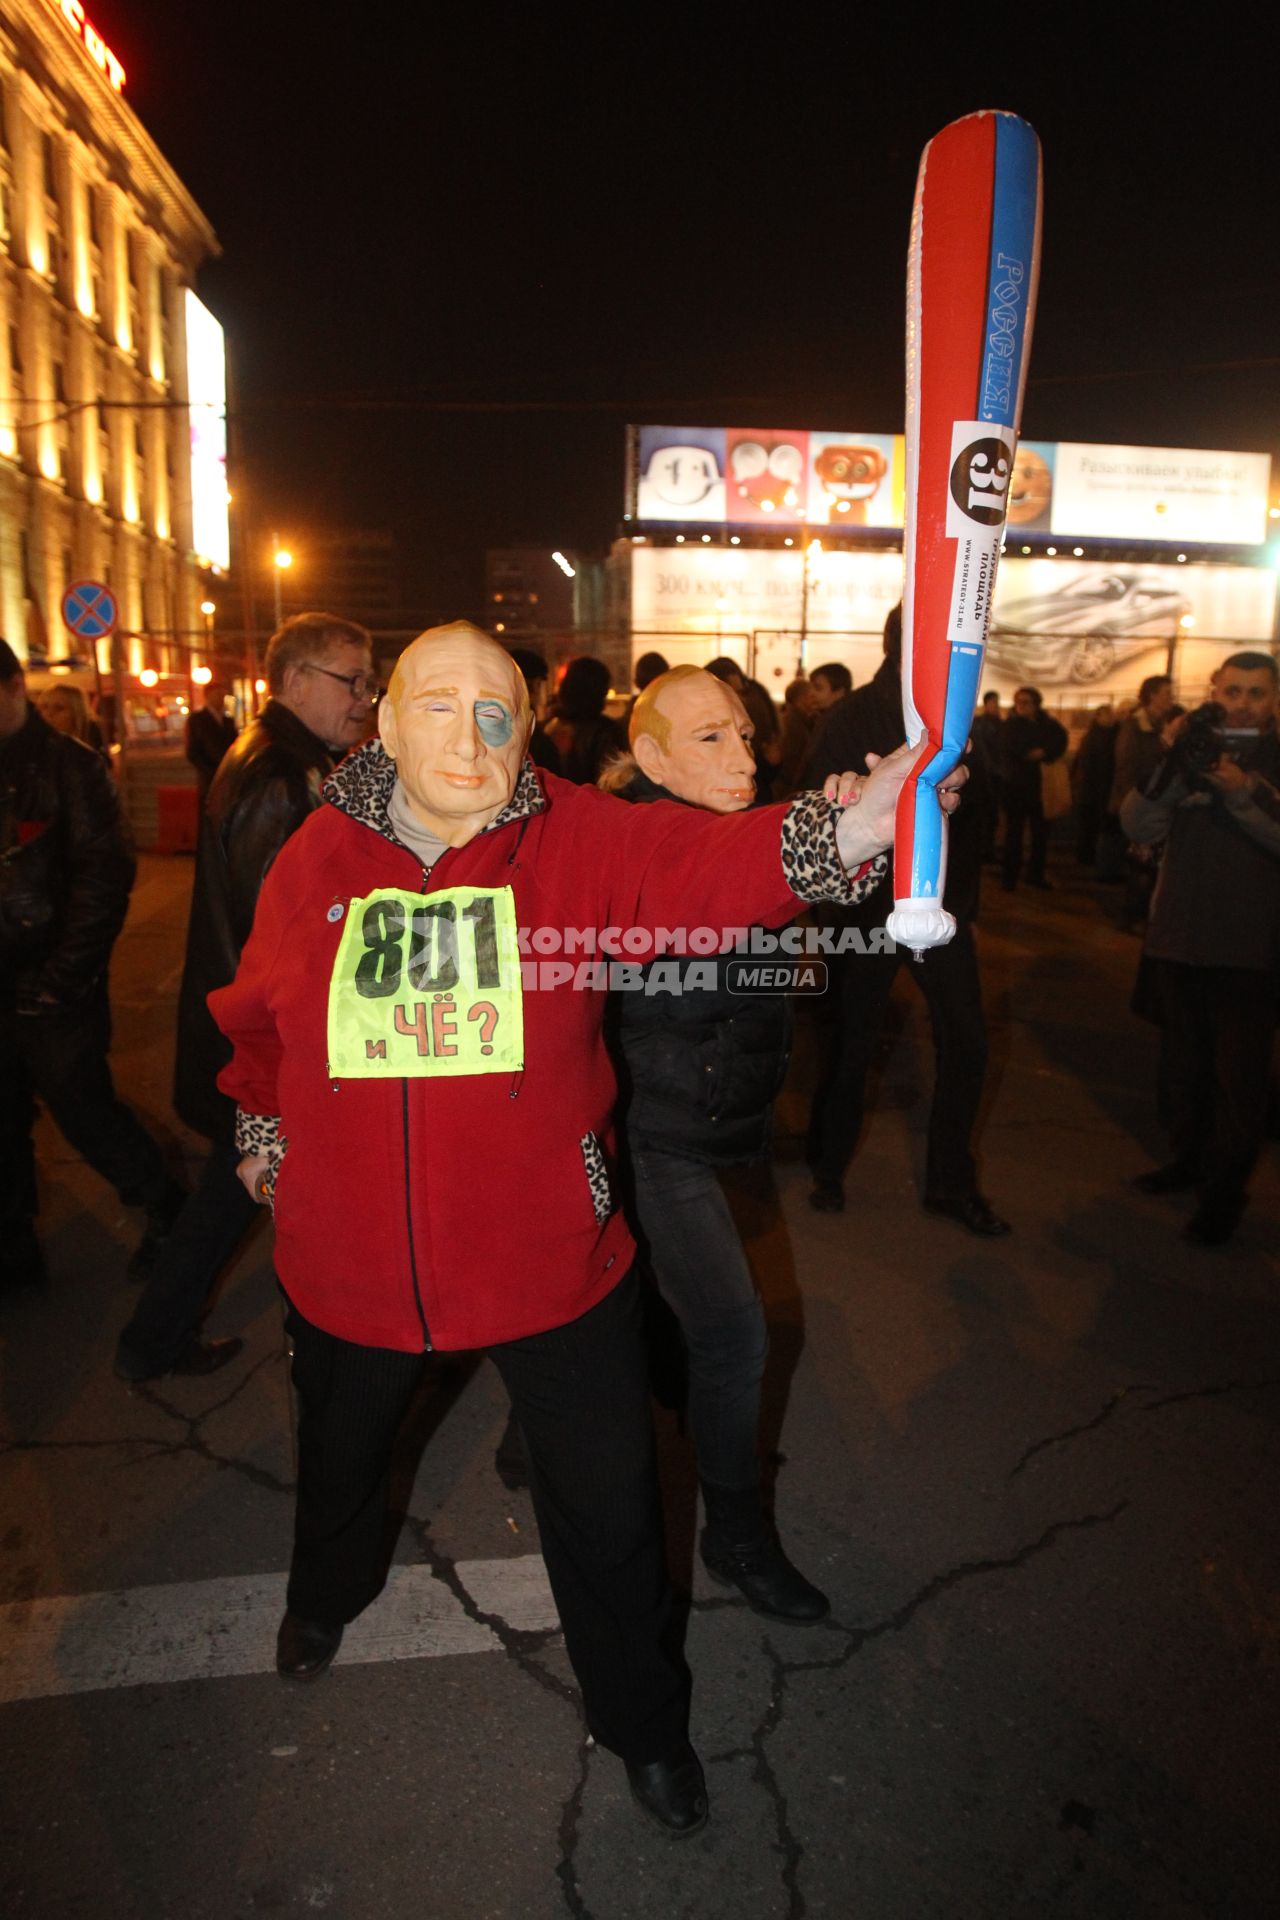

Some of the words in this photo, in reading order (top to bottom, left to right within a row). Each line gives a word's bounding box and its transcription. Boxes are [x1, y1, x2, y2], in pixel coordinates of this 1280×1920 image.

[967, 451, 1009, 513] 31
[957, 539, 972, 629] WWW.STRATEGY-31.RU
[974, 552, 989, 621] ПЛОЩАДЬ
[982, 538, 999, 641] ТРИУМФАЛЬНАЯ
[355, 896, 501, 999] 801
